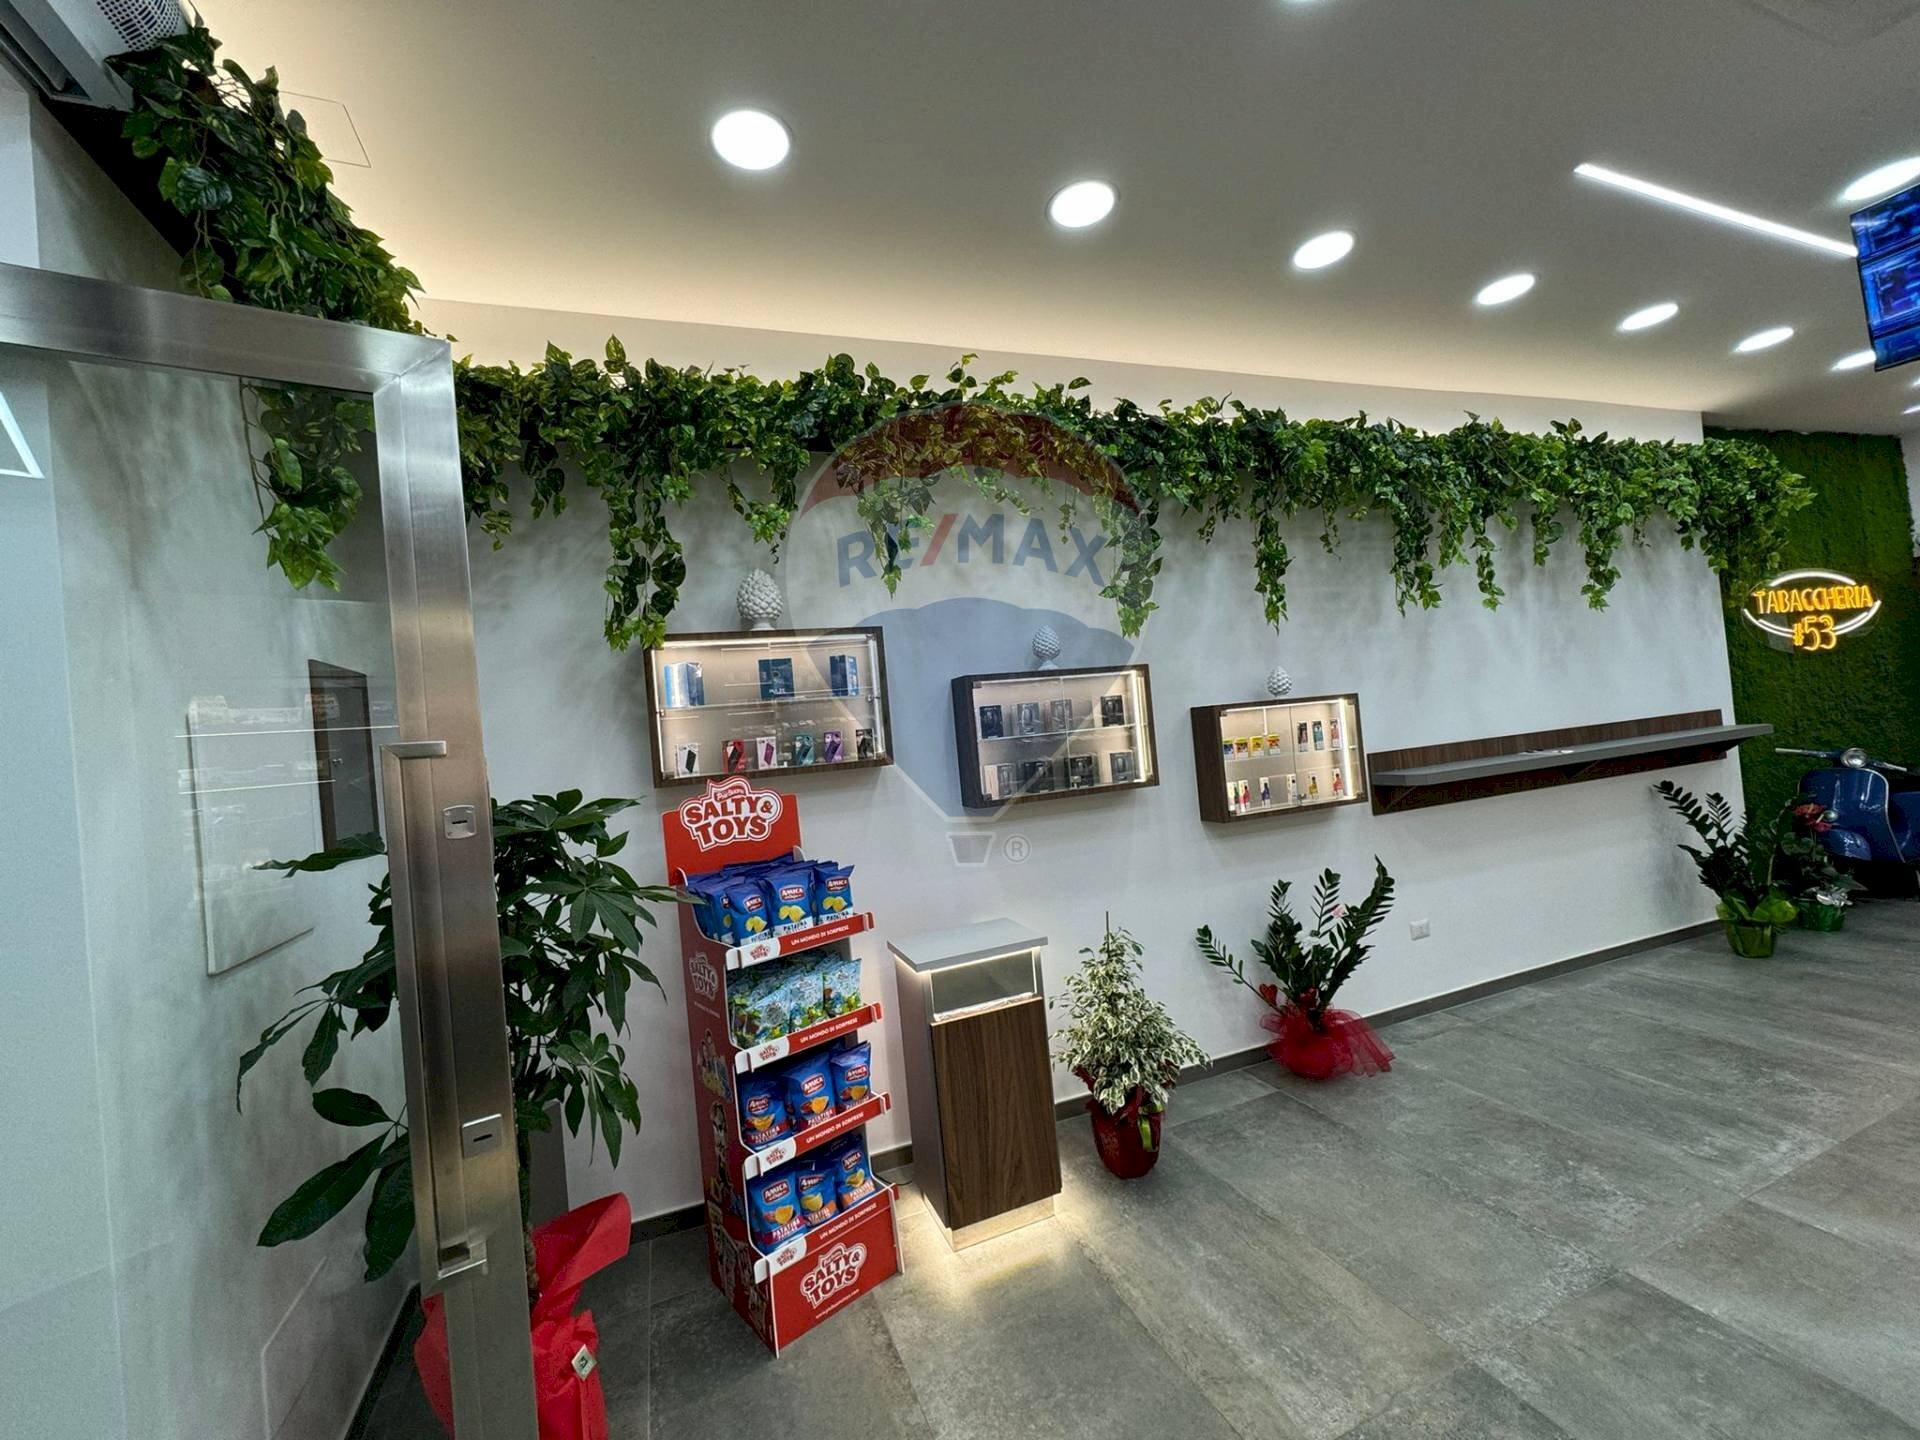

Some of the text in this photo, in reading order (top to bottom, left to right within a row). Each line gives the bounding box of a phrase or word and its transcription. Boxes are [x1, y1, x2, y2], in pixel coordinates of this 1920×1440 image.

[1752, 585, 1873, 614] TABACCHERIA
[685, 796, 761, 825] SALTY
[695, 816, 767, 846] TOYS
[781, 888, 804, 896] AMICA
[764, 1182, 788, 1199] AMICA
[804, 1253, 851, 1292] SALTY
[811, 1266, 857, 1304] TOYS
